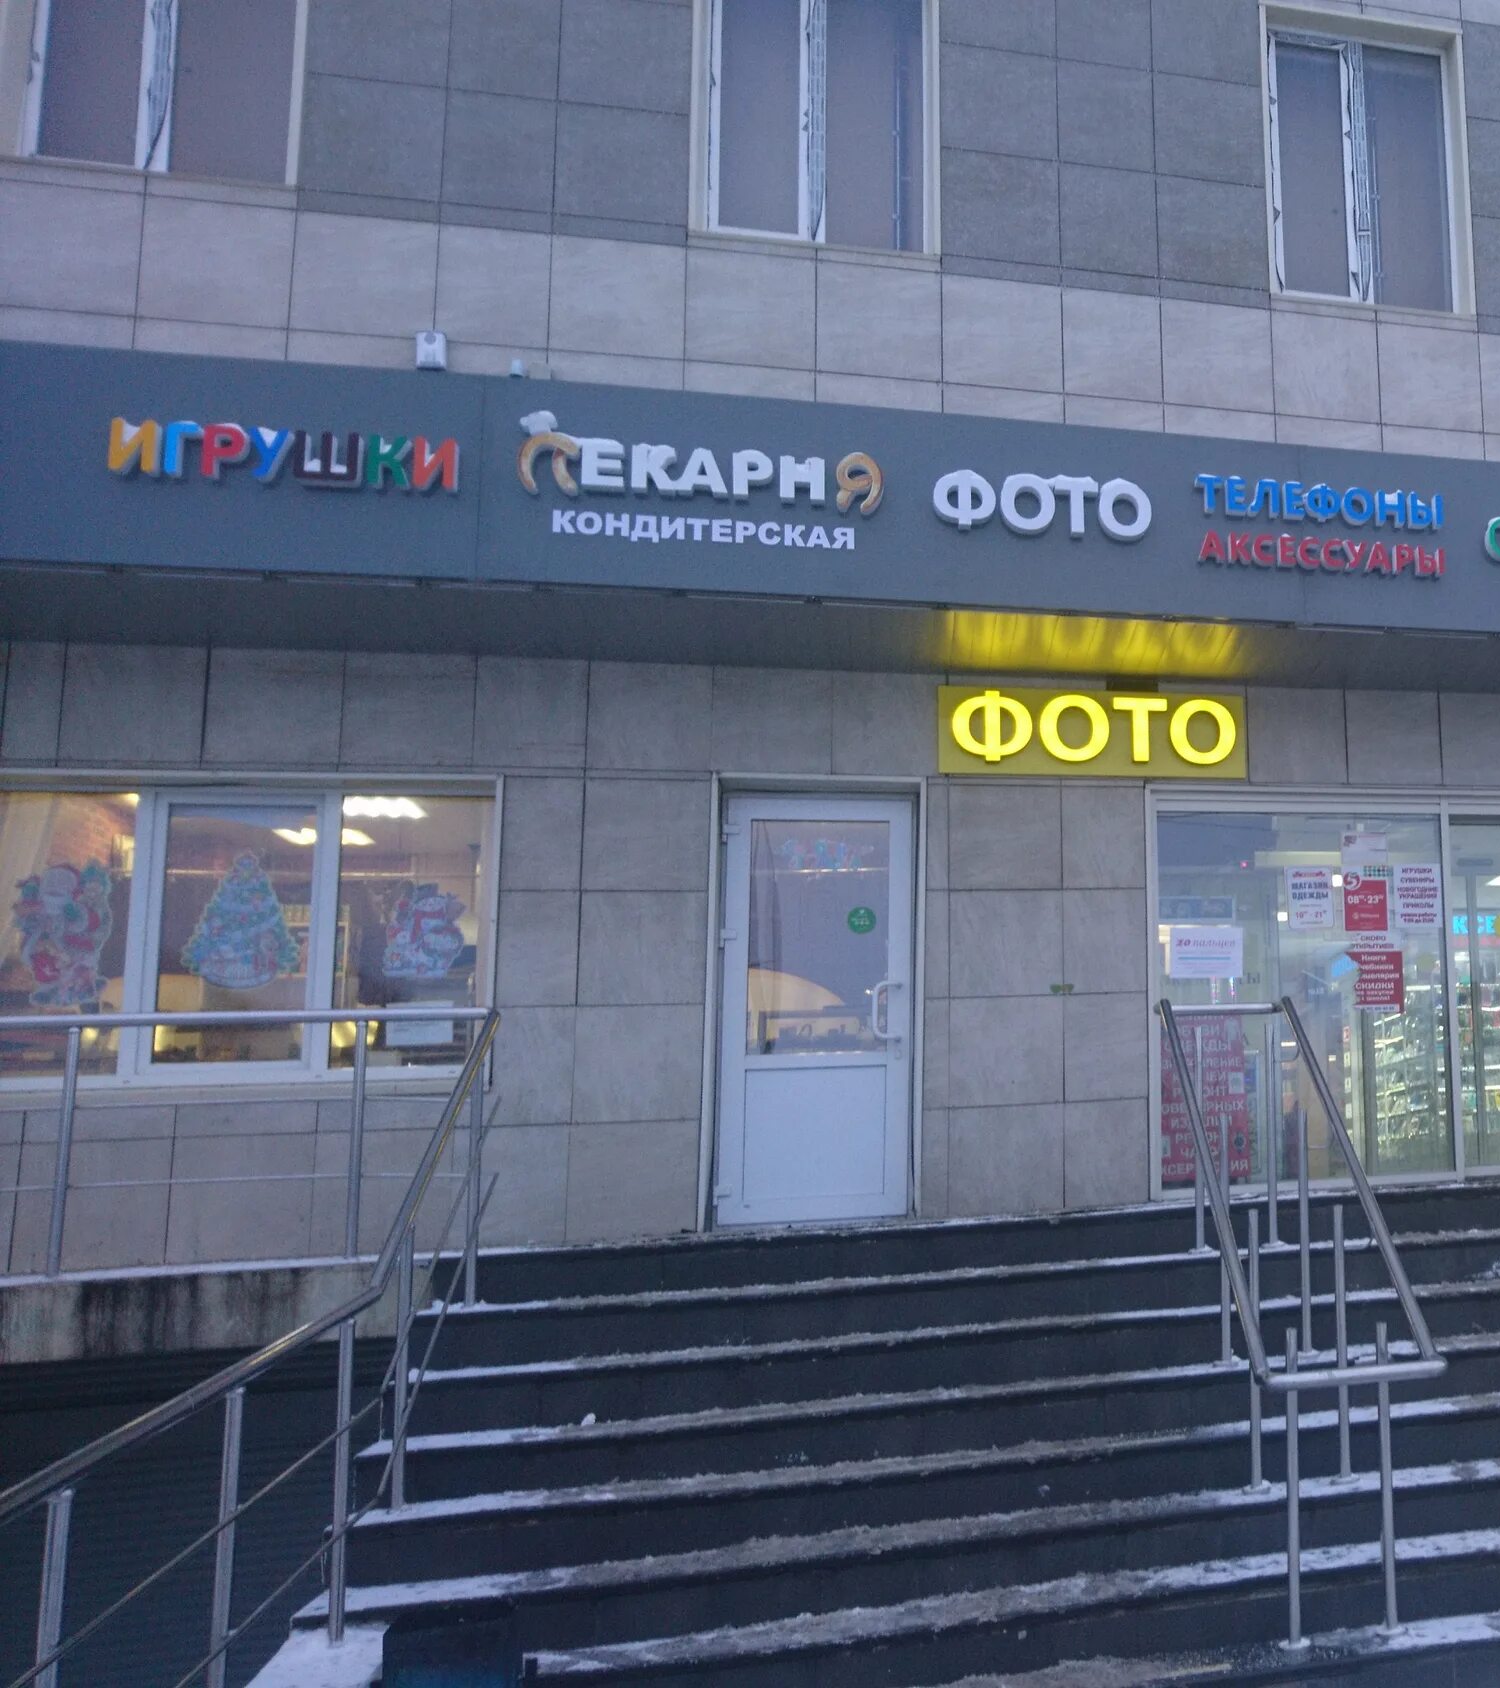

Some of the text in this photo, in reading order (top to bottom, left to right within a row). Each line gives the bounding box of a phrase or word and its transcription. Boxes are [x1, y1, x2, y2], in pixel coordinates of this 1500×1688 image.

[107, 417, 460, 492] ИГРУШКИ
[518, 426, 885, 515] ПЕКАРНЯ
[551, 508, 856, 551] КОНДИТЕРСКАЯ
[933, 470, 1153, 542] ФОТО
[1195, 473, 1444, 530] ТЕЛЕФОНЫ
[1199, 531, 1446, 578] АКСЕССУАРЫ
[952, 690, 1236, 765] ФОТО
